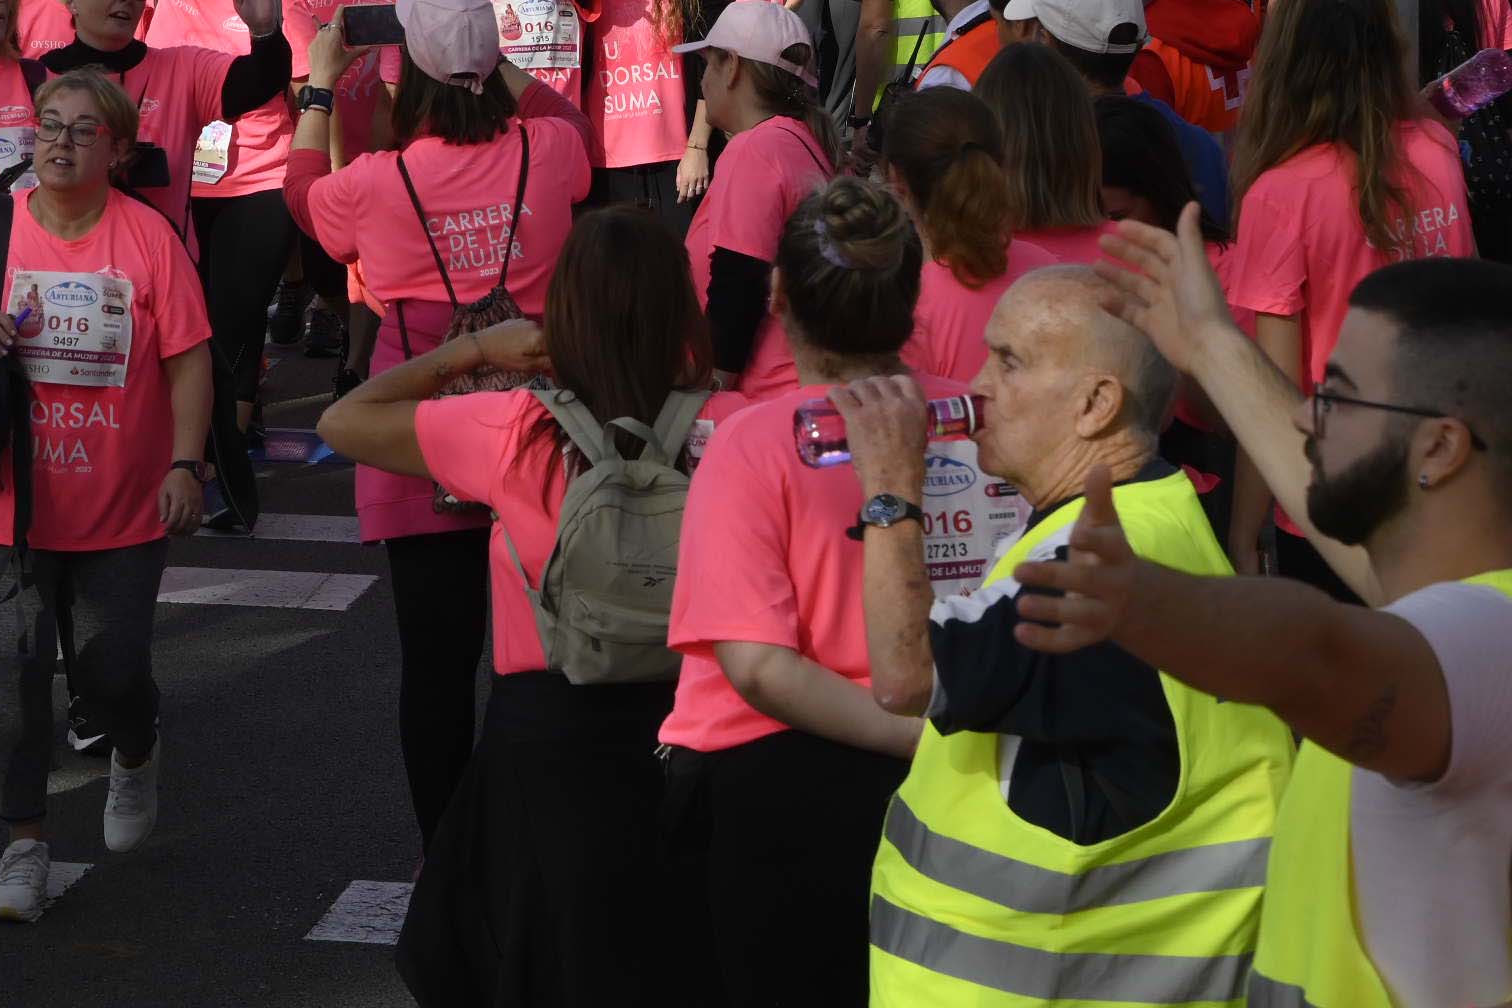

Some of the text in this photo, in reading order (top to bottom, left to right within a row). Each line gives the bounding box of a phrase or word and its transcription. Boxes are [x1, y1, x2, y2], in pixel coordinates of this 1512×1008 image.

[525, 21, 554, 33] 016
[31, 40, 66, 50] OYSHO
[600, 61, 679, 89] DORSAL
[604, 89, 661, 114] SUMA
[426, 203, 532, 237] CARRERA
[449, 226, 515, 253] DE LA
[449, 243, 524, 272] MUJER
[50, 290, 94, 302] ASTURIANA
[48, 316, 89, 333] 016
[54, 336, 79, 347] 9497
[80, 368, 116, 377] Santander
[927, 543, 968, 559] 27213
[932, 566, 957, 576] DE LA
